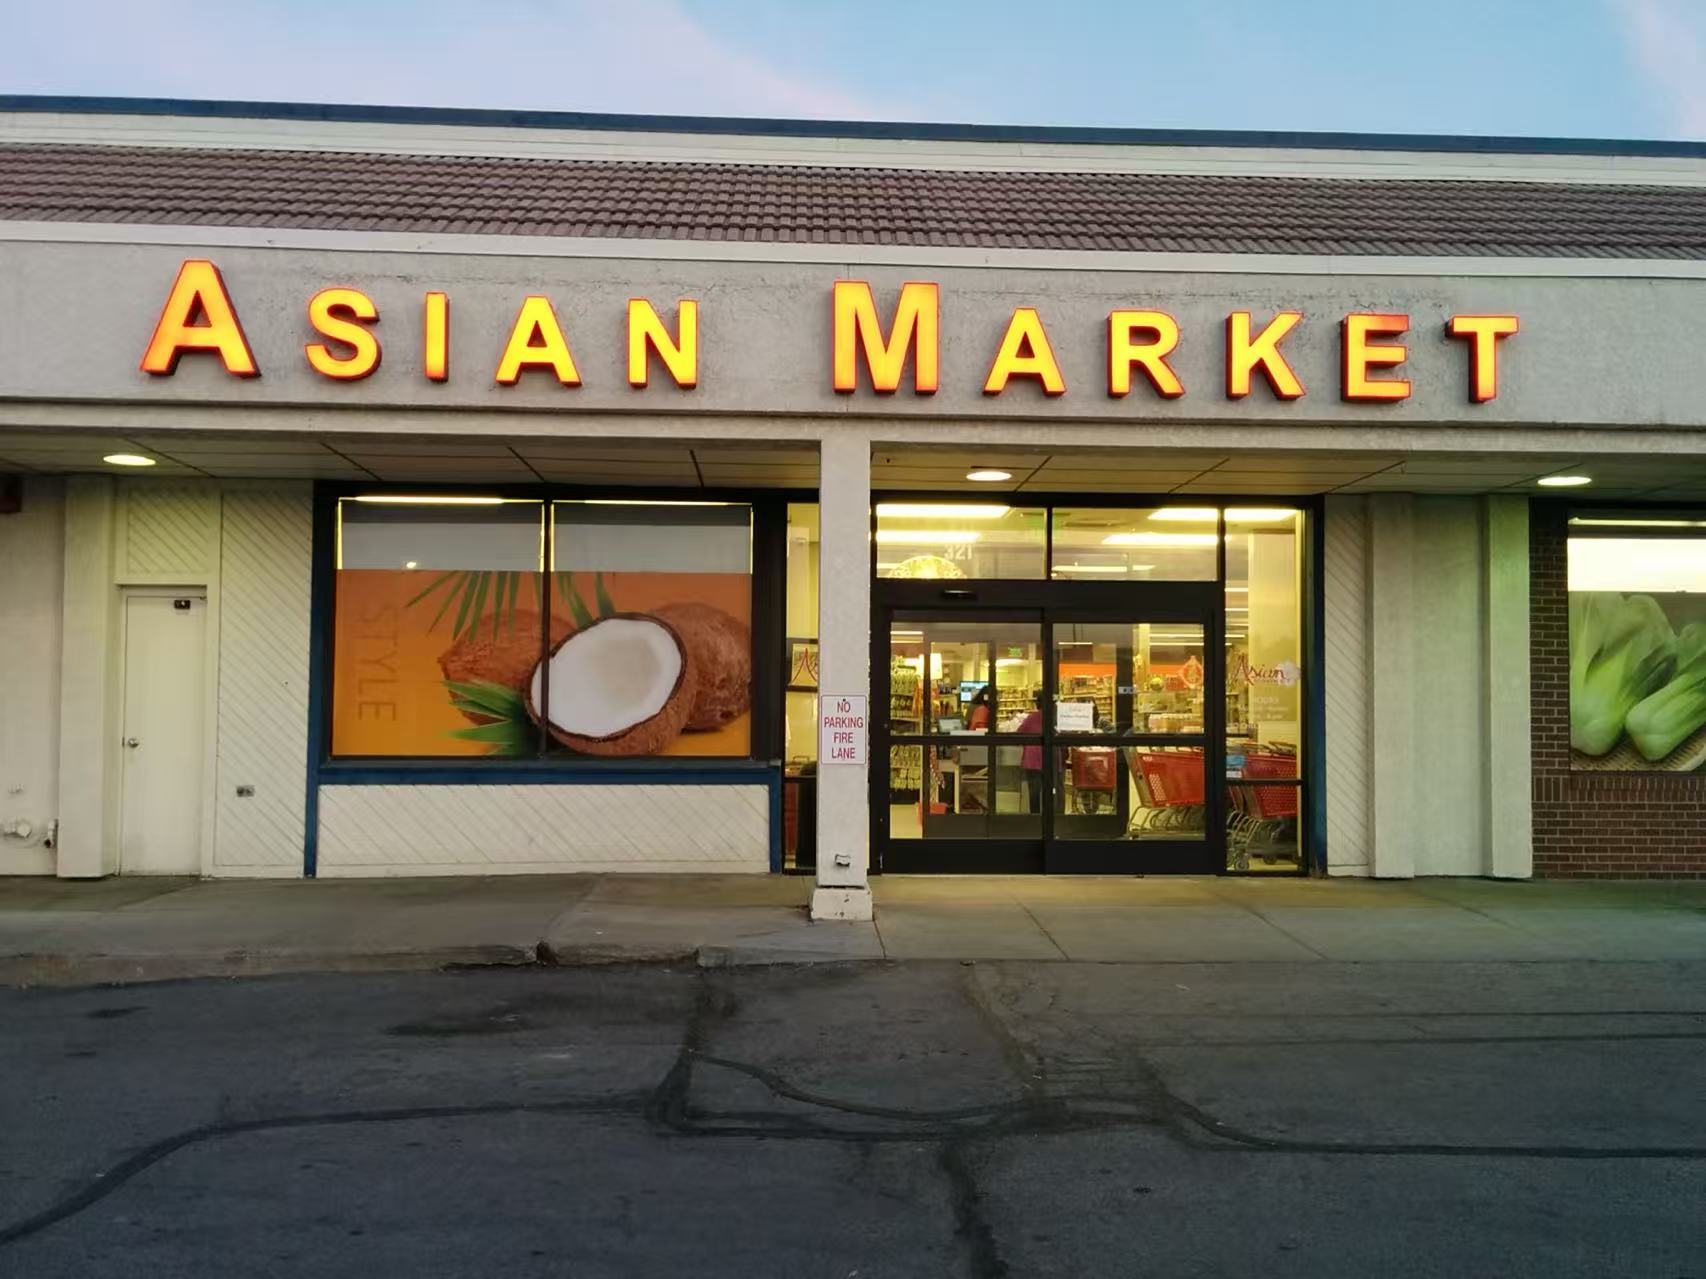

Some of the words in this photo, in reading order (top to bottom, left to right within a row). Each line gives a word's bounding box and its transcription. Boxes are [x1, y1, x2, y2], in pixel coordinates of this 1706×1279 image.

[140, 257, 698, 390] ASIAN
[832, 281, 1521, 403] MARKET
[356, 603, 400, 721] STYLE
[837, 701, 851, 713] NO
[824, 716, 864, 728] PARKING
[833, 732, 854, 743] FIRE
[832, 747, 856, 759] LANE
